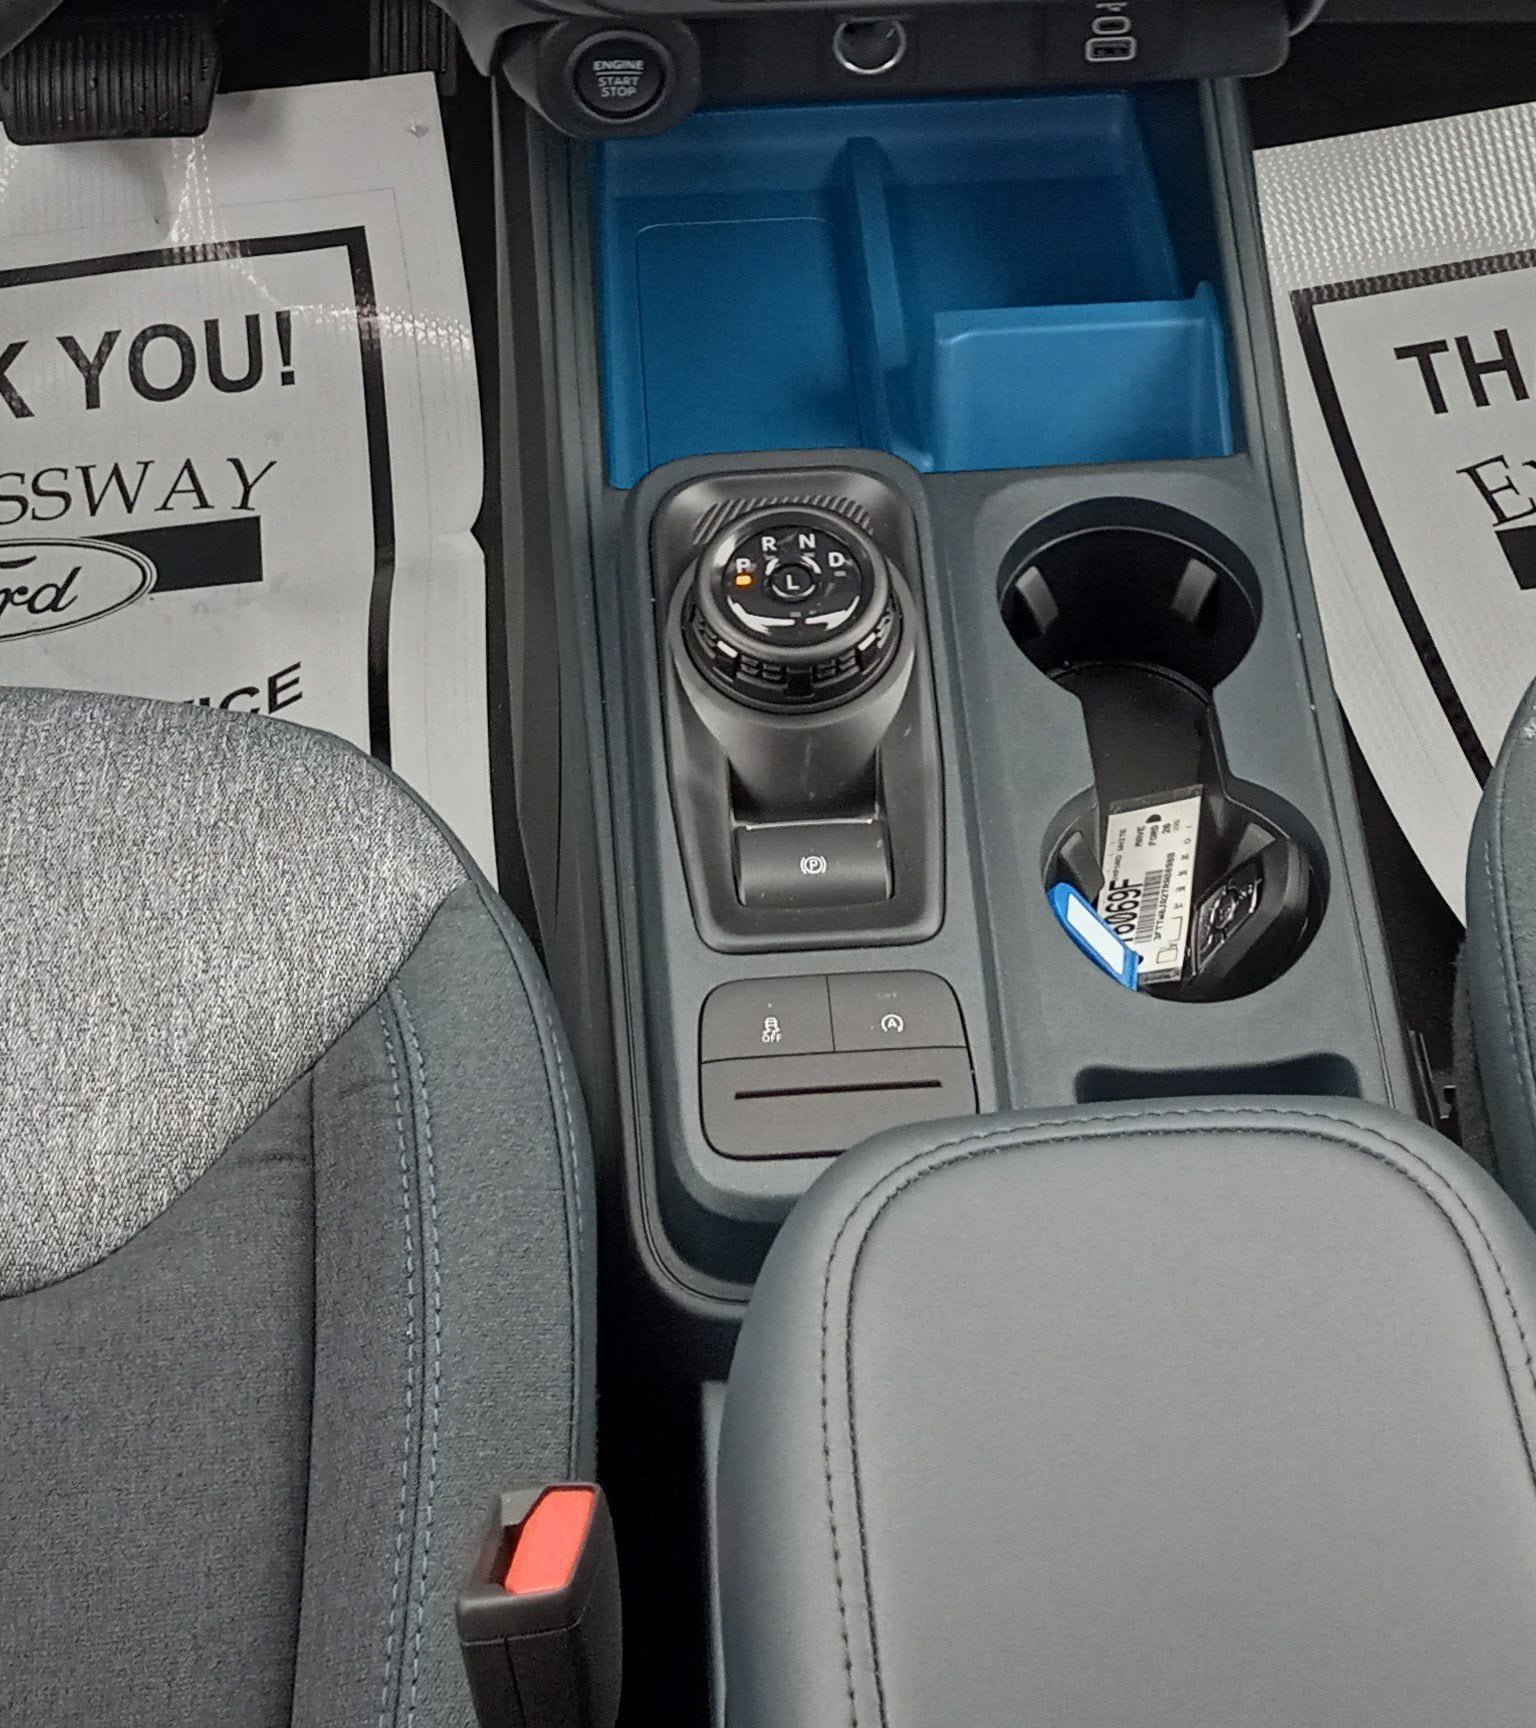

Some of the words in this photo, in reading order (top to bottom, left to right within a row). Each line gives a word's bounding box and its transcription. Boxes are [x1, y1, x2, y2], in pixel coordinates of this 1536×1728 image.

[592, 59, 645, 71] ENGINE
[598, 76, 640, 87] START
[601, 87, 637, 98] STOP
[56, 309, 298, 411] YOU!
[761, 536, 778, 552] R
[798, 533, 816, 549] N
[736, 558, 752, 573] P
[828, 552, 846, 567] D
[786, 574, 800, 590] L
[762, 1032, 782, 1043] OFF
